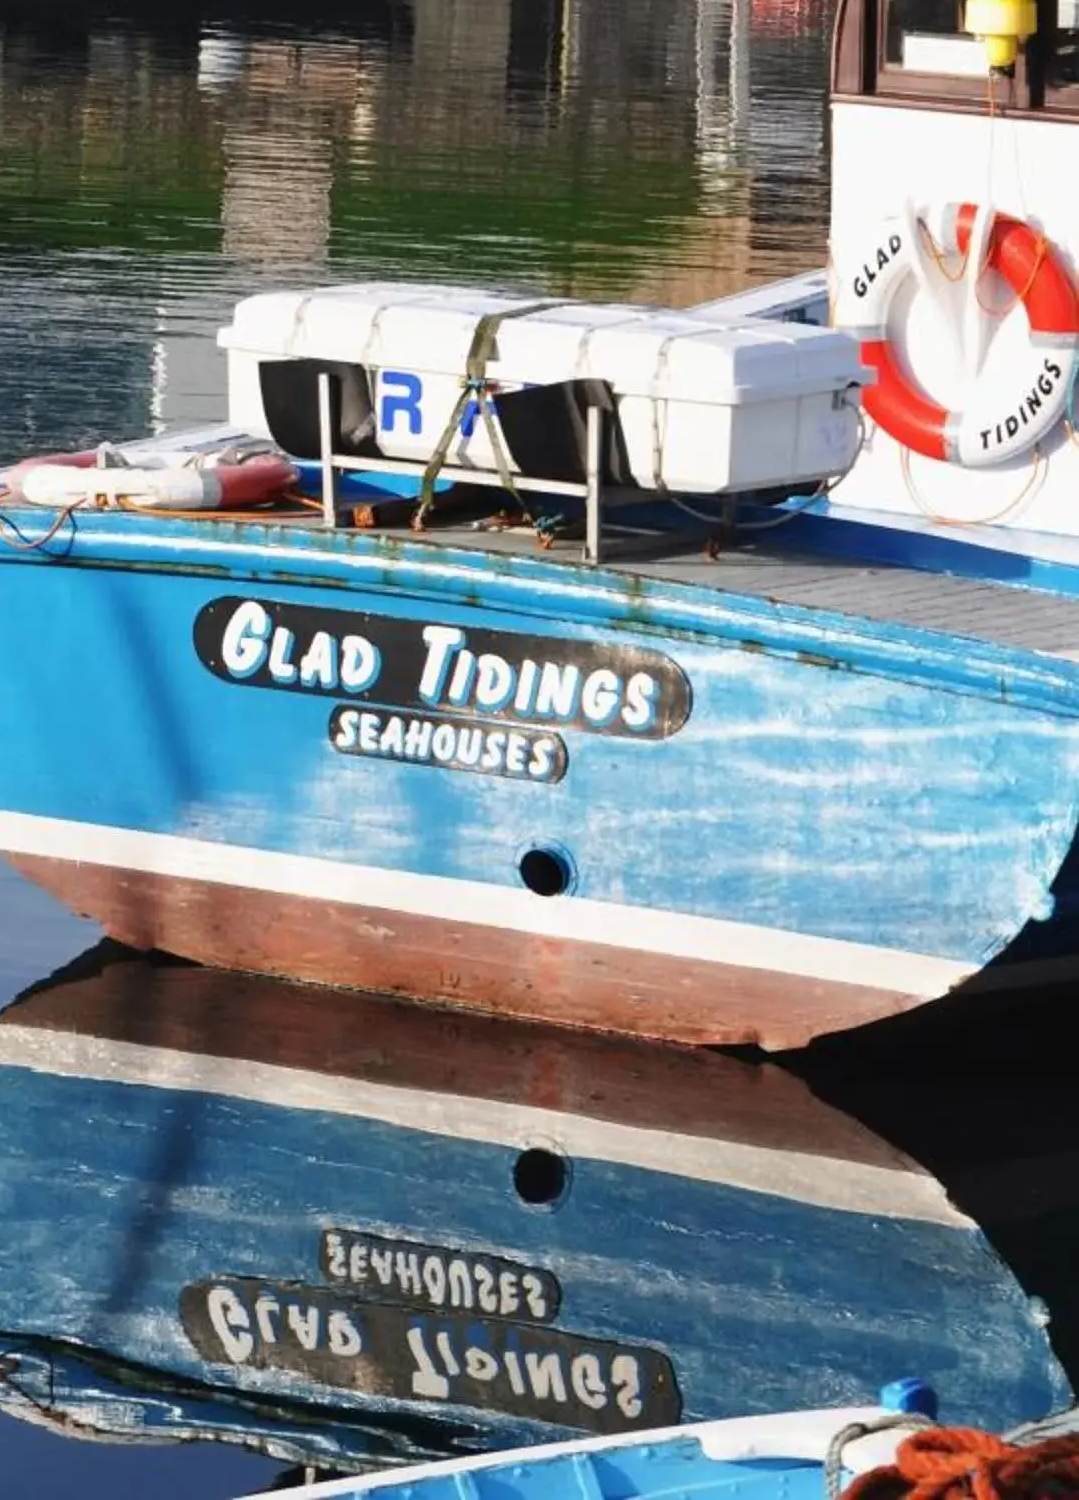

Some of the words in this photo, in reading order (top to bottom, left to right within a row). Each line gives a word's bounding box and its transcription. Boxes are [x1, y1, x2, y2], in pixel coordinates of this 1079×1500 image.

[854, 234, 902, 299] GLAD
[979, 357, 1062, 450] TIDINGS
[222, 601, 381, 693] GLAD
[420, 625, 659, 731] TIDINGS
[335, 710, 556, 778] SEAHOUSES
